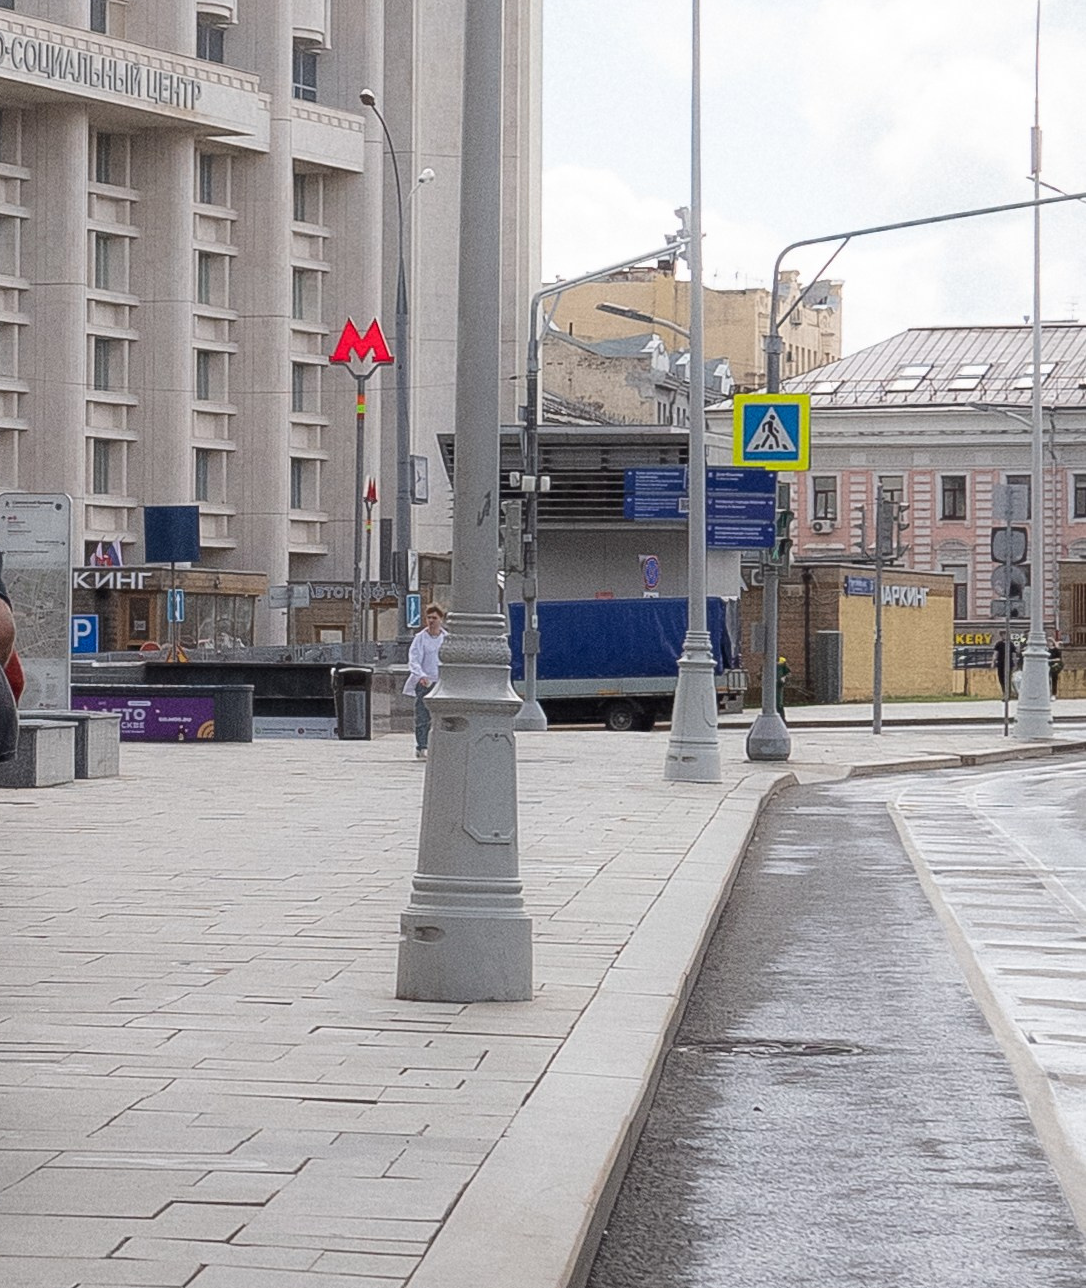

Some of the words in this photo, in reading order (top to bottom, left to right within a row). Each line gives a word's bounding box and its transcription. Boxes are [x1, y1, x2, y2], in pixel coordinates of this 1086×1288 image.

[145, 67, 203, 112] ЦЕНТР
[73, 571, 153, 590] КИНГ
[73, 618, 93, 648] P
[955, 633, 992, 646] KERY
